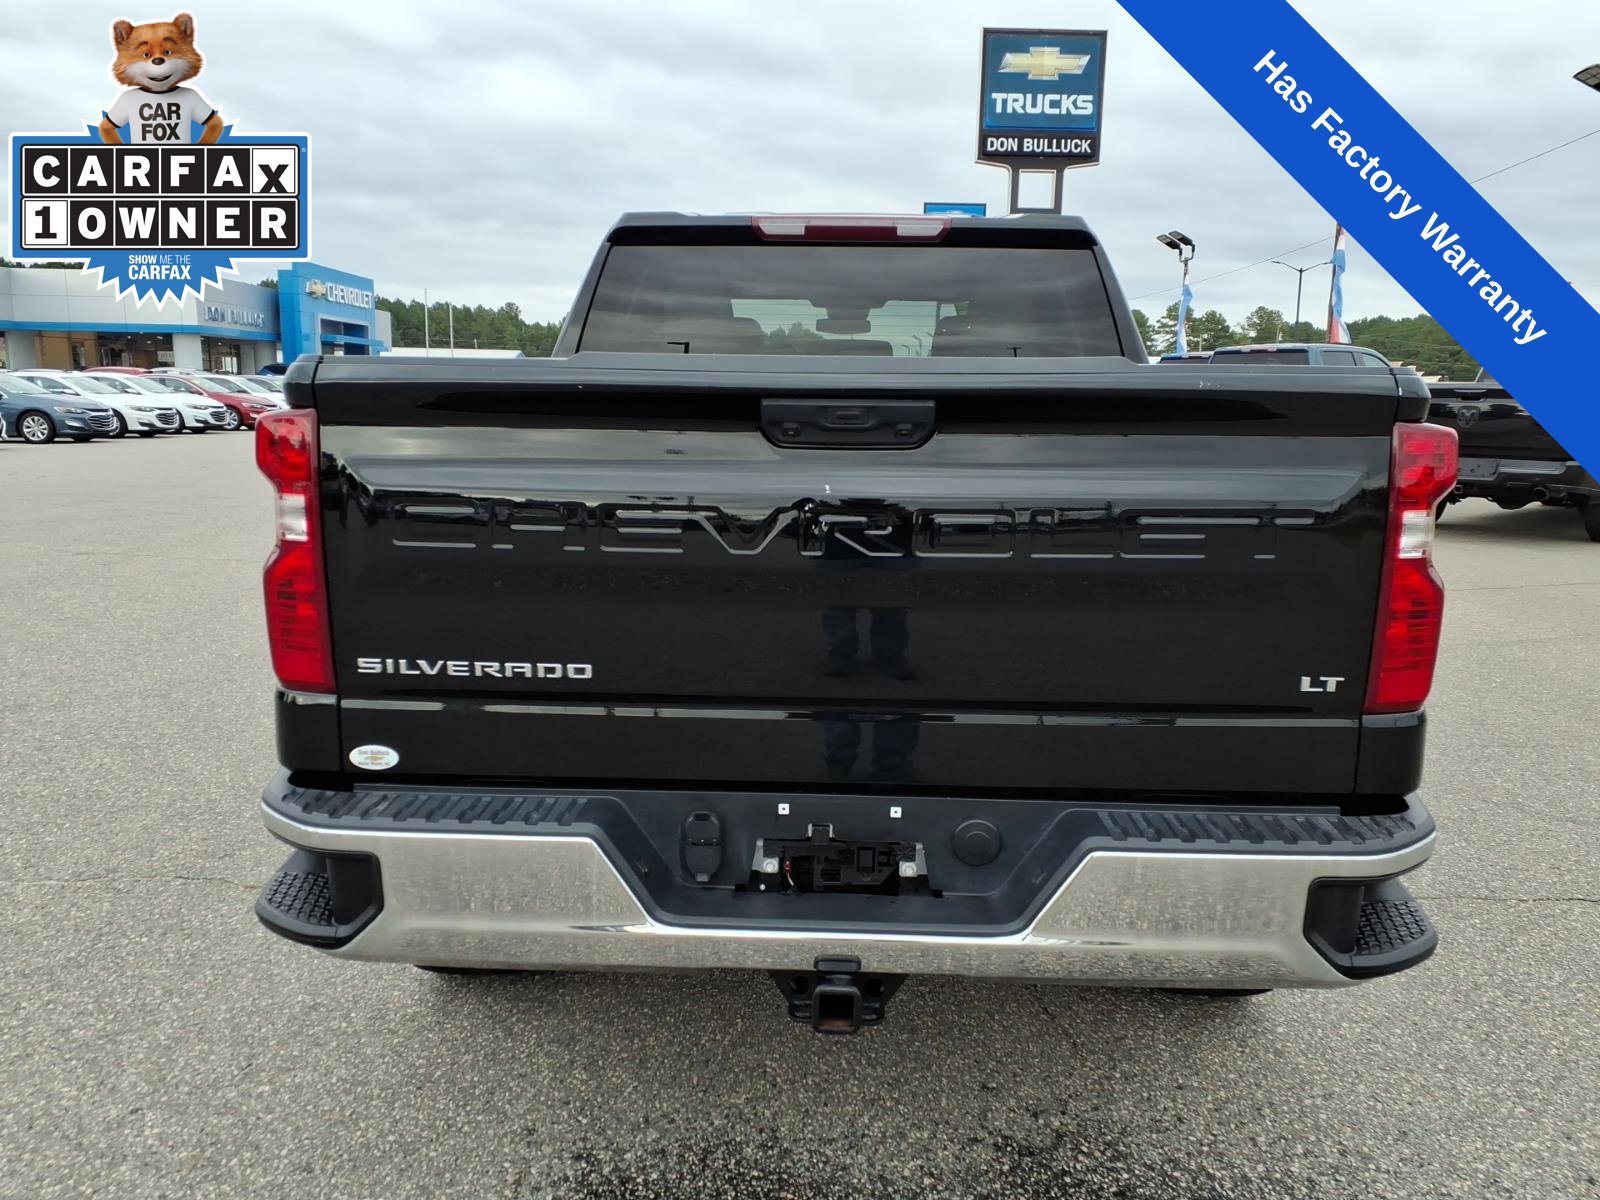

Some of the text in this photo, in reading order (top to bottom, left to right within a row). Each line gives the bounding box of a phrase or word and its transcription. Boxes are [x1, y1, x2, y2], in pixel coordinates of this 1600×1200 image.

[991, 92, 1094, 115] TRUCKS
[986, 137, 1091, 153] DON BULLUCK
[326, 281, 372, 309] CHEVROLET
[356, 657, 593, 679] SILVERADO
[1300, 676, 1345, 692] LT
